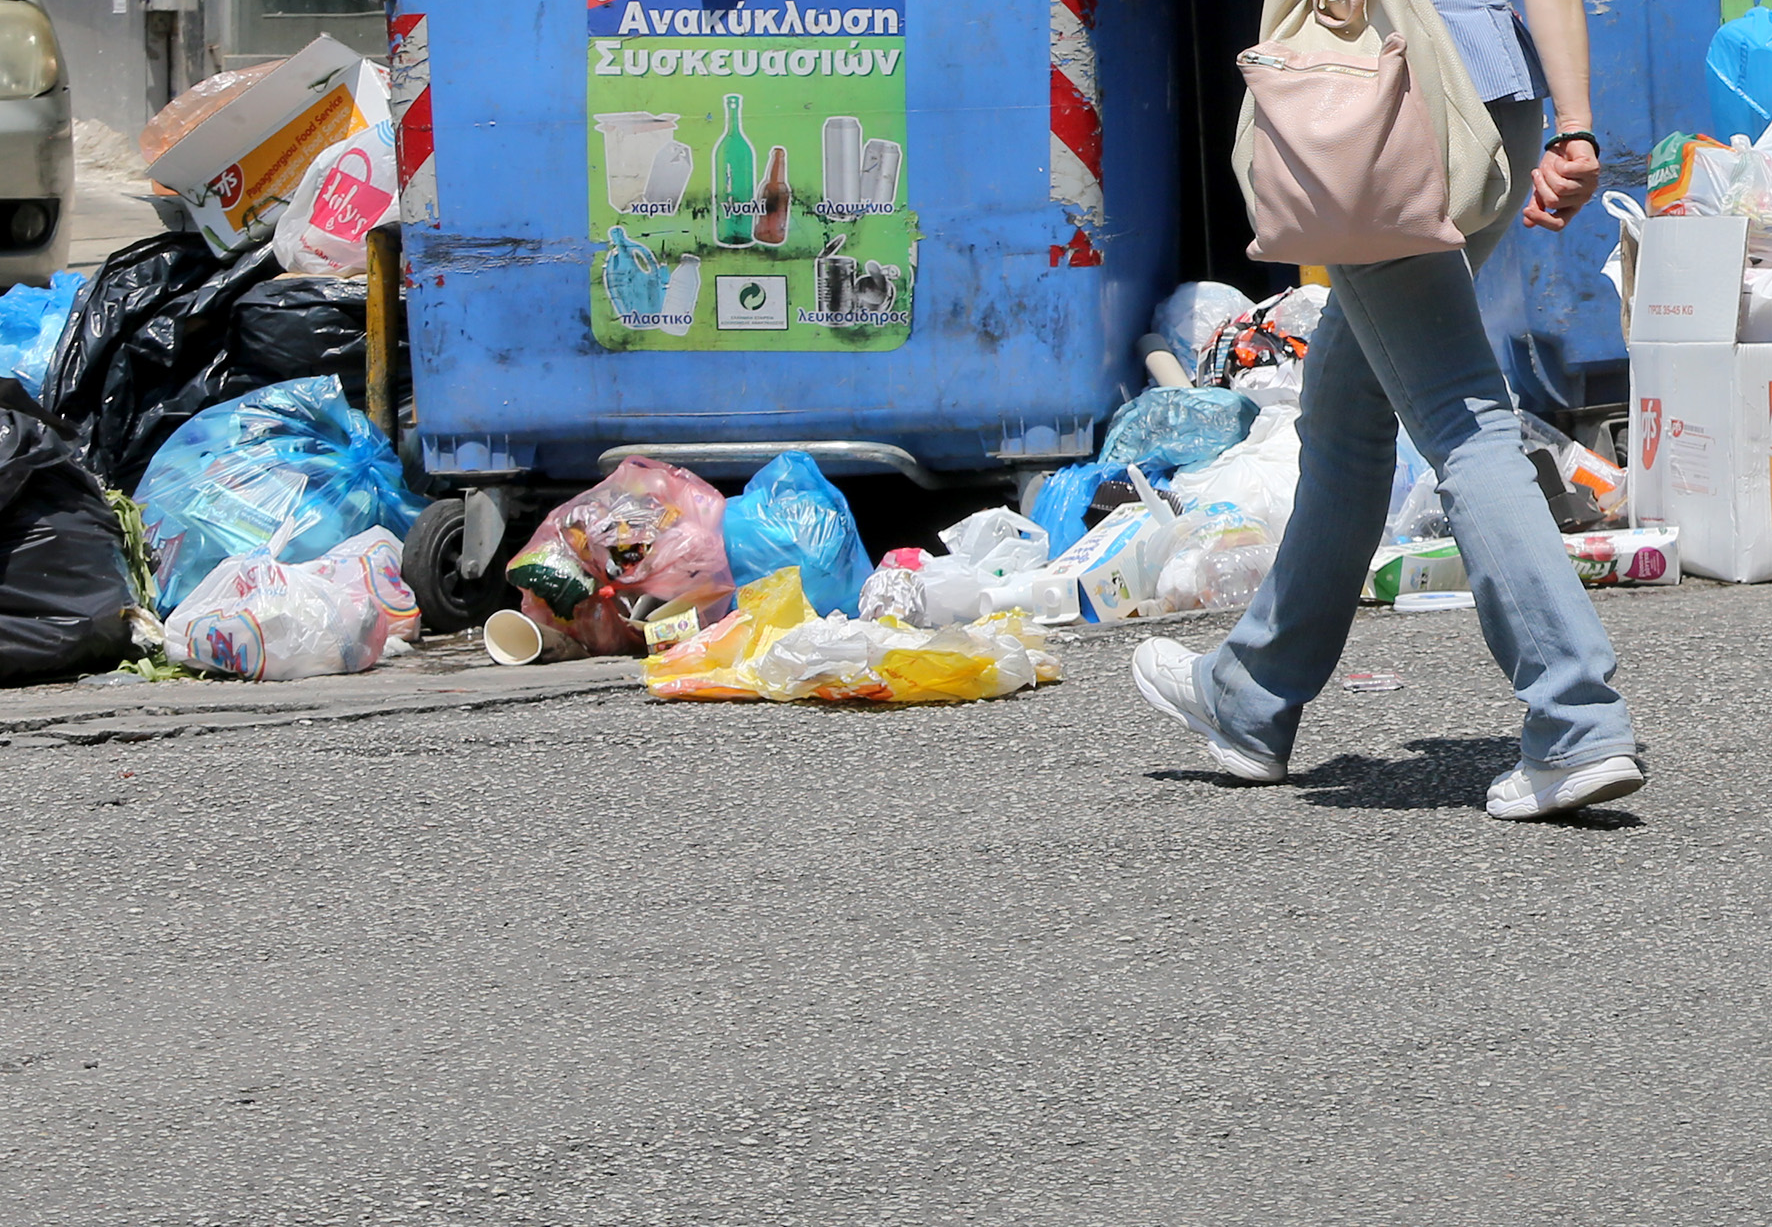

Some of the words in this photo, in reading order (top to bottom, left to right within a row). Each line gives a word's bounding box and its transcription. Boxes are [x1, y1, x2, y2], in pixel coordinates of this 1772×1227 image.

[618, 0, 900, 36] Ανακύκλωση
[595, 40, 901, 76] Συσκευασιών
[246, 140, 299, 200] Papageorgiou
[295, 119, 317, 146] Food
[314, 94, 344, 126] Service
[632, 200, 673, 218] χαρτί
[723, 200, 768, 217] γυαλί
[816, 200, 894, 216] αλουμίνιο
[622, 311, 693, 326] πλαστικό
[798, 310, 909, 327] λευκοσίδηρος
